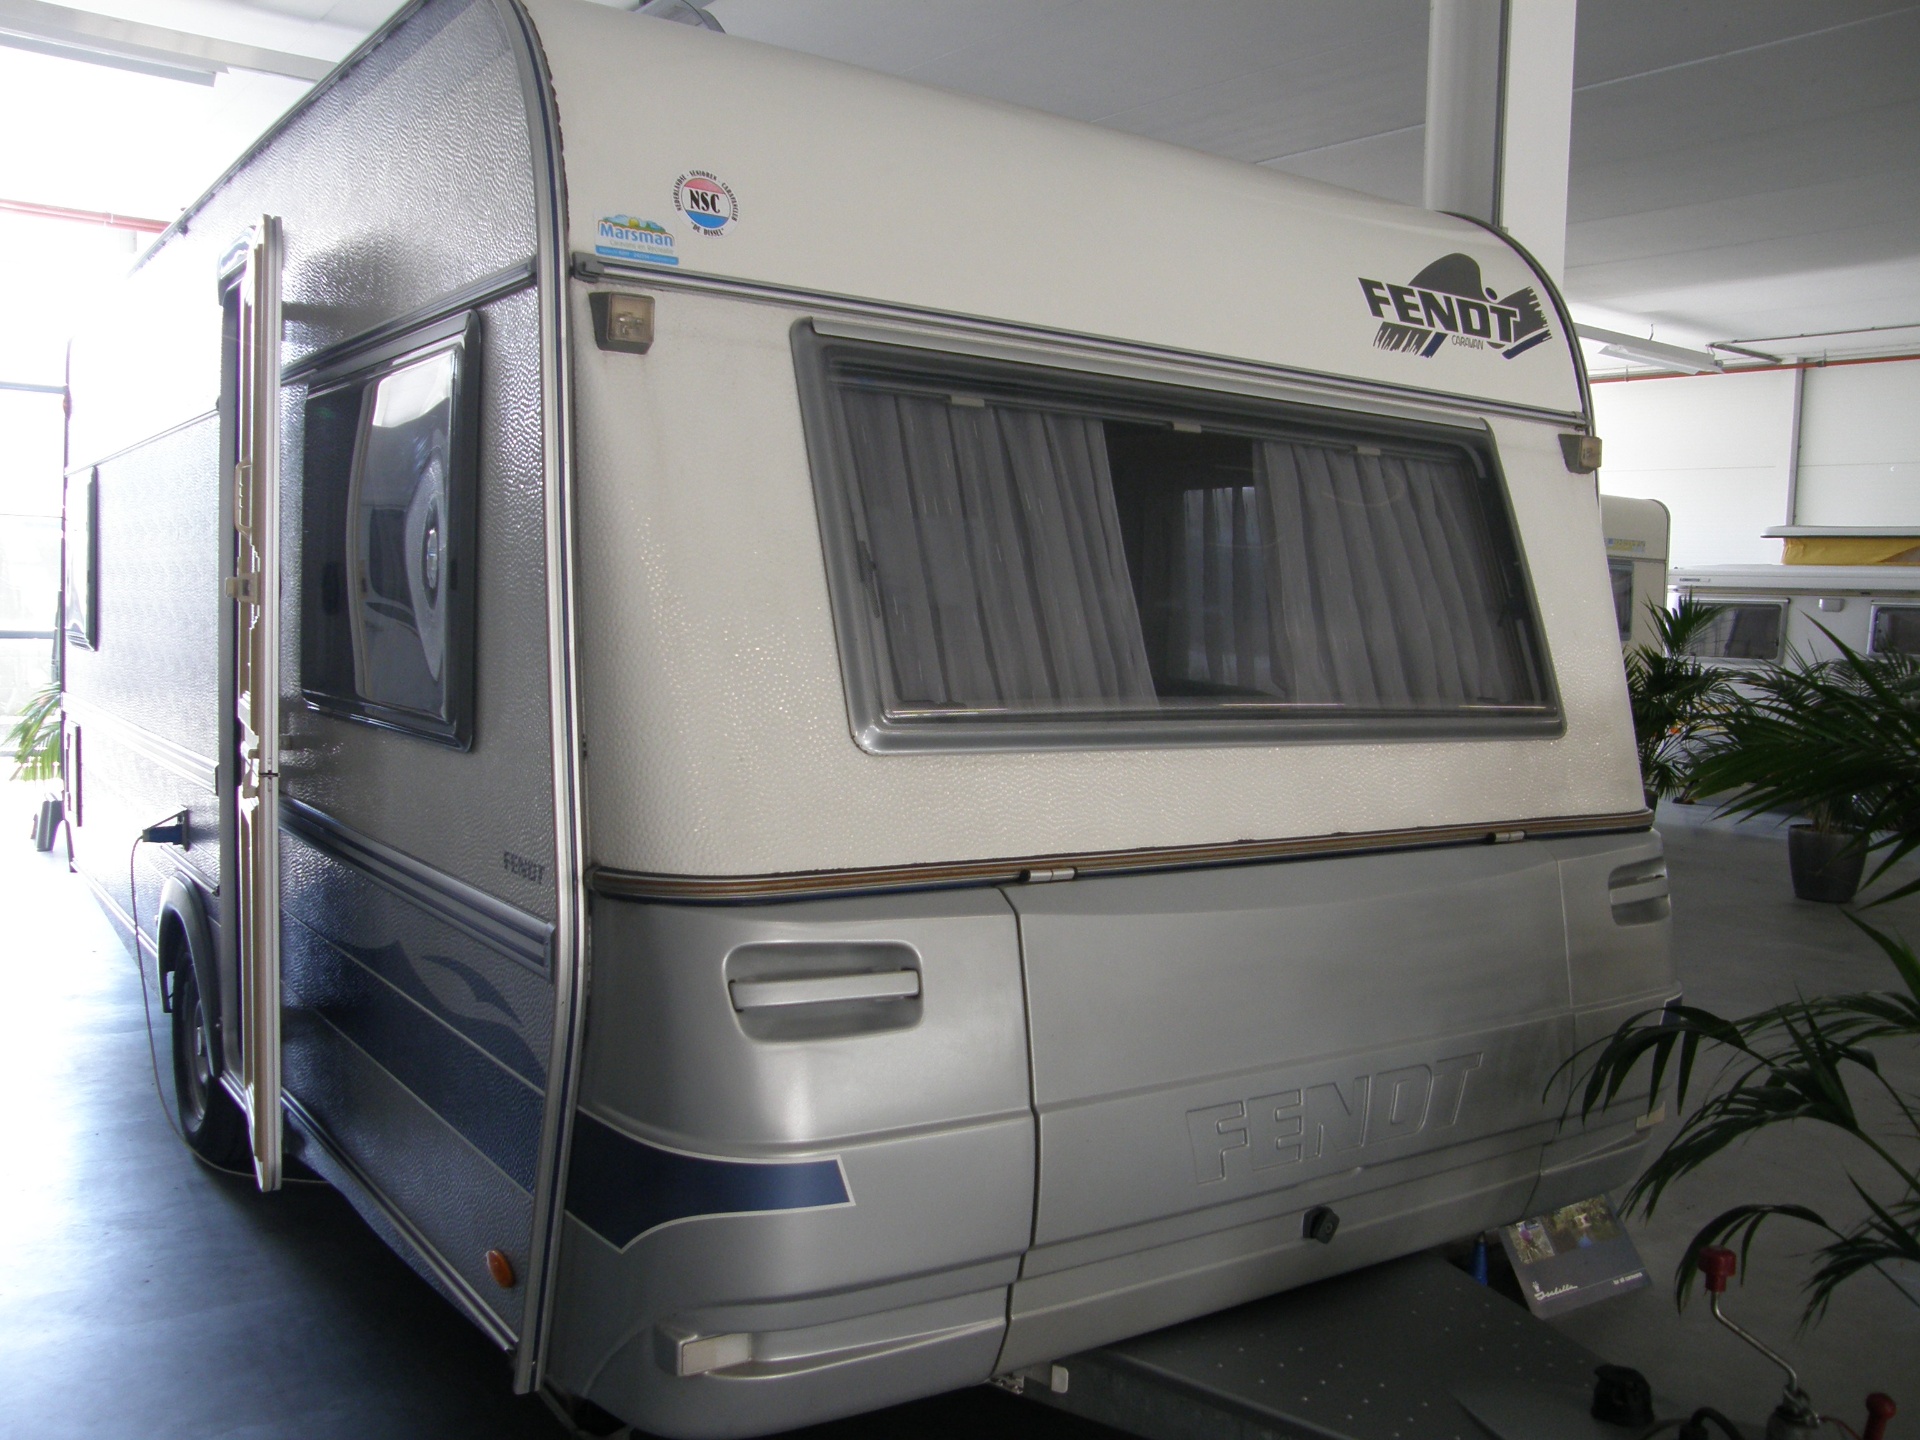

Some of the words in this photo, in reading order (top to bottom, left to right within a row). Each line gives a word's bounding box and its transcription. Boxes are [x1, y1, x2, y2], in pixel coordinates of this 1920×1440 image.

[689, 189, 721, 214] NSC
[600, 223, 674, 247] Marsman
[1358, 277, 1518, 344] FENDT
[1451, 335, 1485, 350] CARAVAN
[503, 851, 546, 885] FENDT
[1185, 1052, 1484, 1186] FENDT
